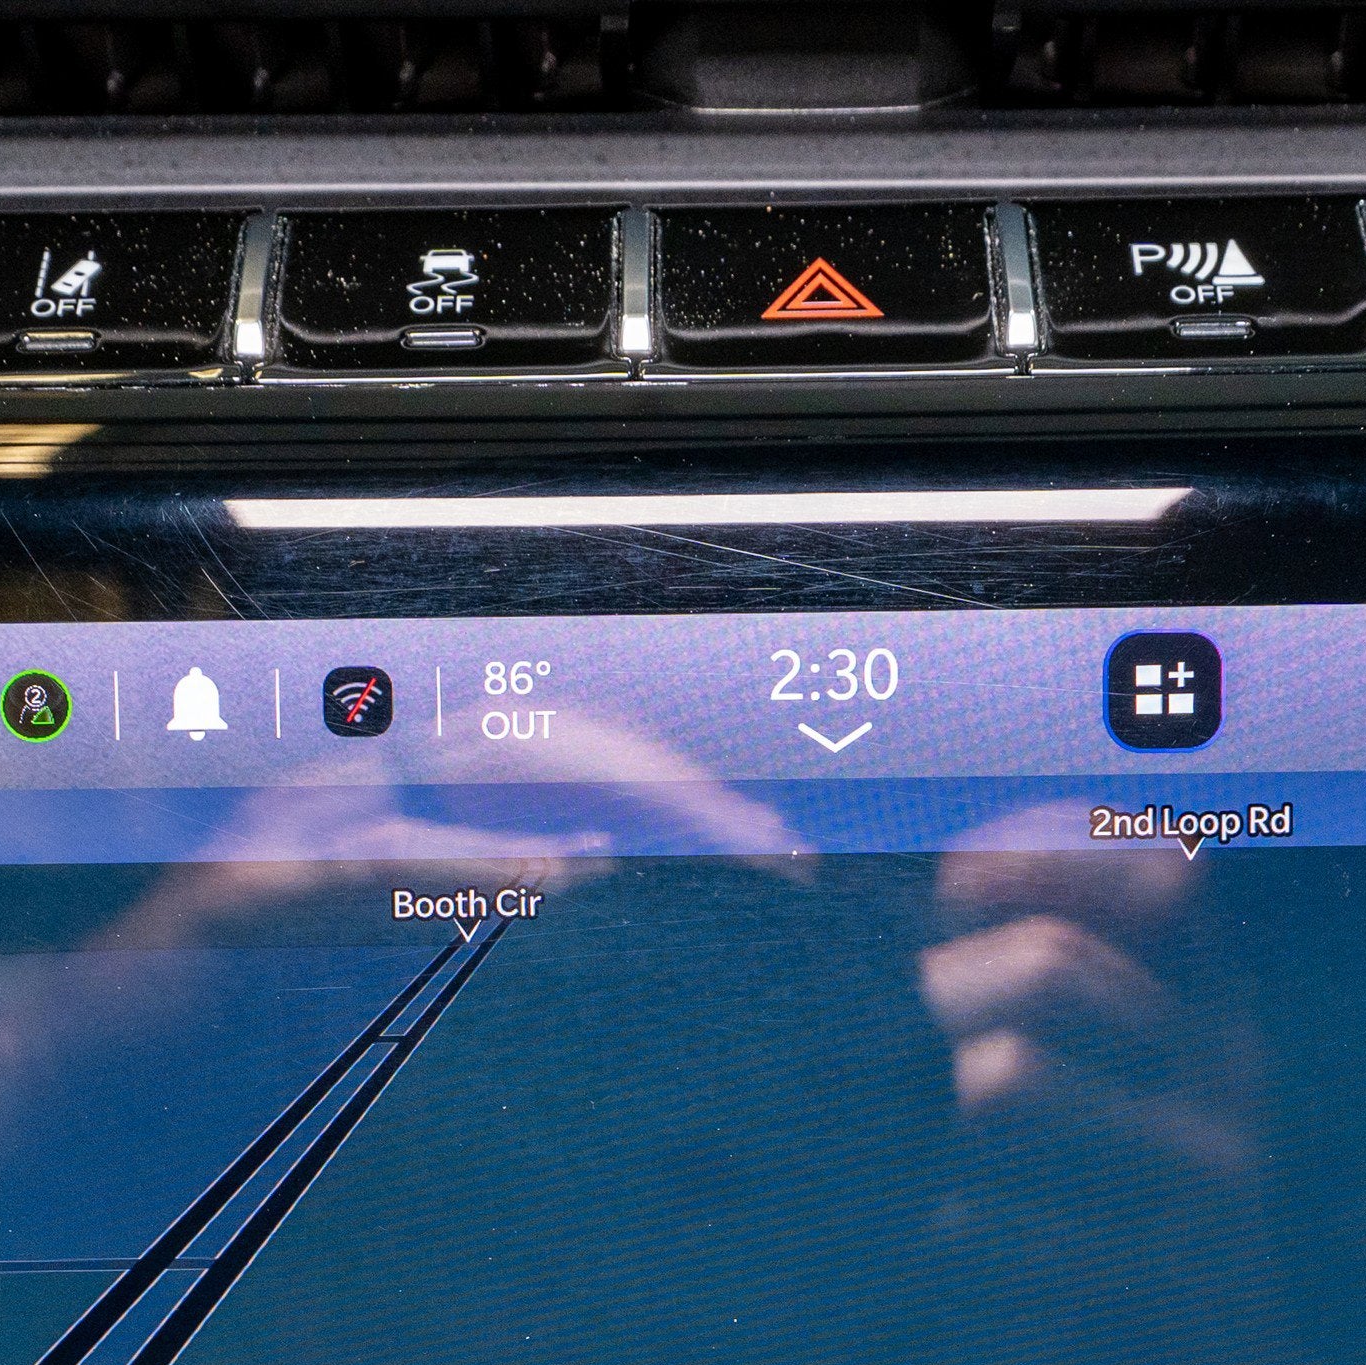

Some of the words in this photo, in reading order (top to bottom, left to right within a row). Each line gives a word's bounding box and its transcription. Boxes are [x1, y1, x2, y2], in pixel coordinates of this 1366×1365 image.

[1131, 244, 1165, 275] P
[31, 298, 96, 316] OFF
[408, 296, 474, 313] OFF
[1170, 285, 1235, 303] OFF
[771, 648, 898, 700] 2:30
[482, 711, 556, 739] OUT
[1093, 808, 1153, 836] 2nd
[1161, 808, 1239, 840] Loop
[1250, 806, 1289, 833] Rd
[395, 890, 486, 917] Booth
[497, 889, 541, 916] Cir
